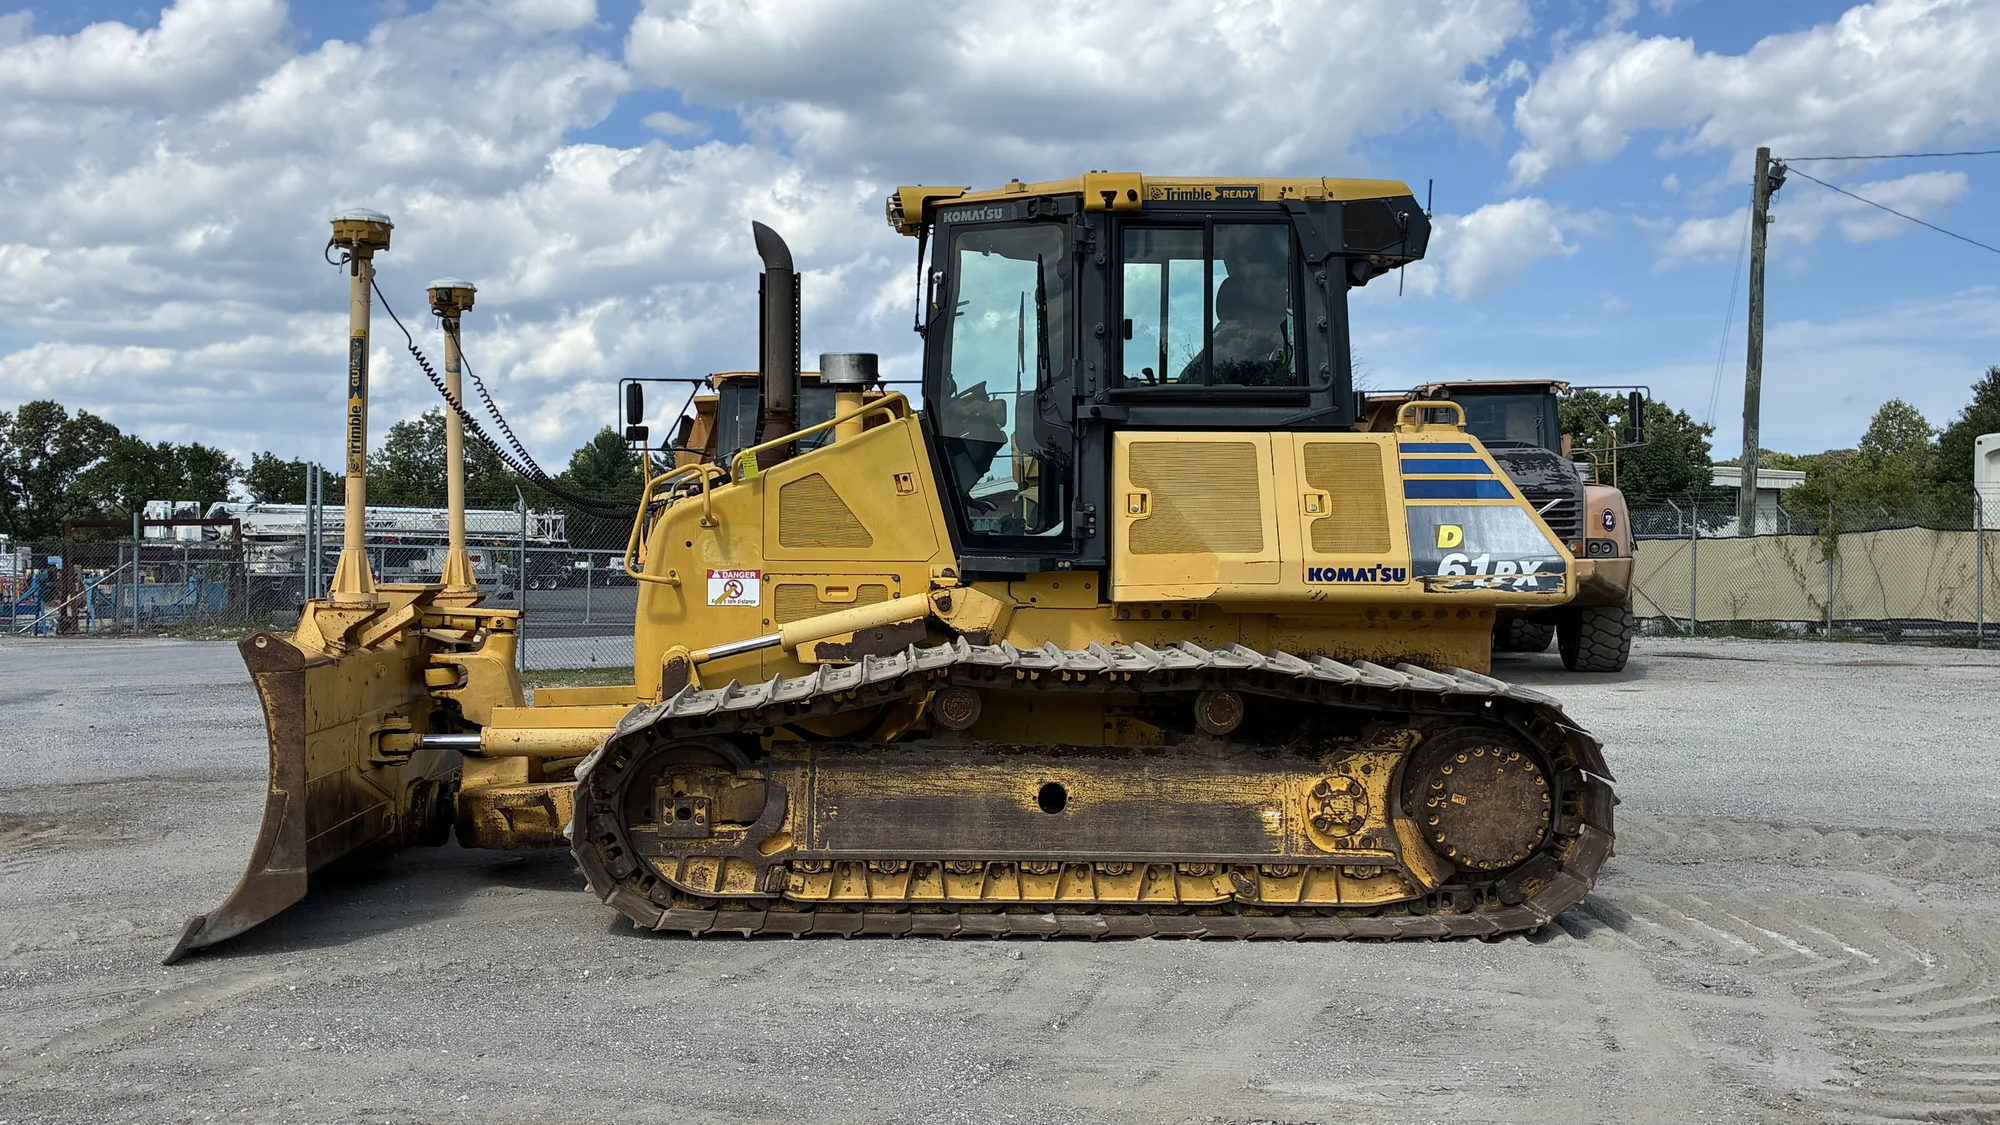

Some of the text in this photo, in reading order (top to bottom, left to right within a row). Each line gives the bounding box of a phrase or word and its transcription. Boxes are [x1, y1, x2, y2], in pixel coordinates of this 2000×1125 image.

[1164, 187, 1256, 201] Trimble READY
[943, 206, 1003, 223] KOMATSU
[1605, 514, 1613, 526] Z
[1437, 524, 1463, 549] D
[722, 571, 756, 579] DANGER
[1308, 563, 1406, 582] KOMATSU
[1437, 552, 1544, 588] 61PX
